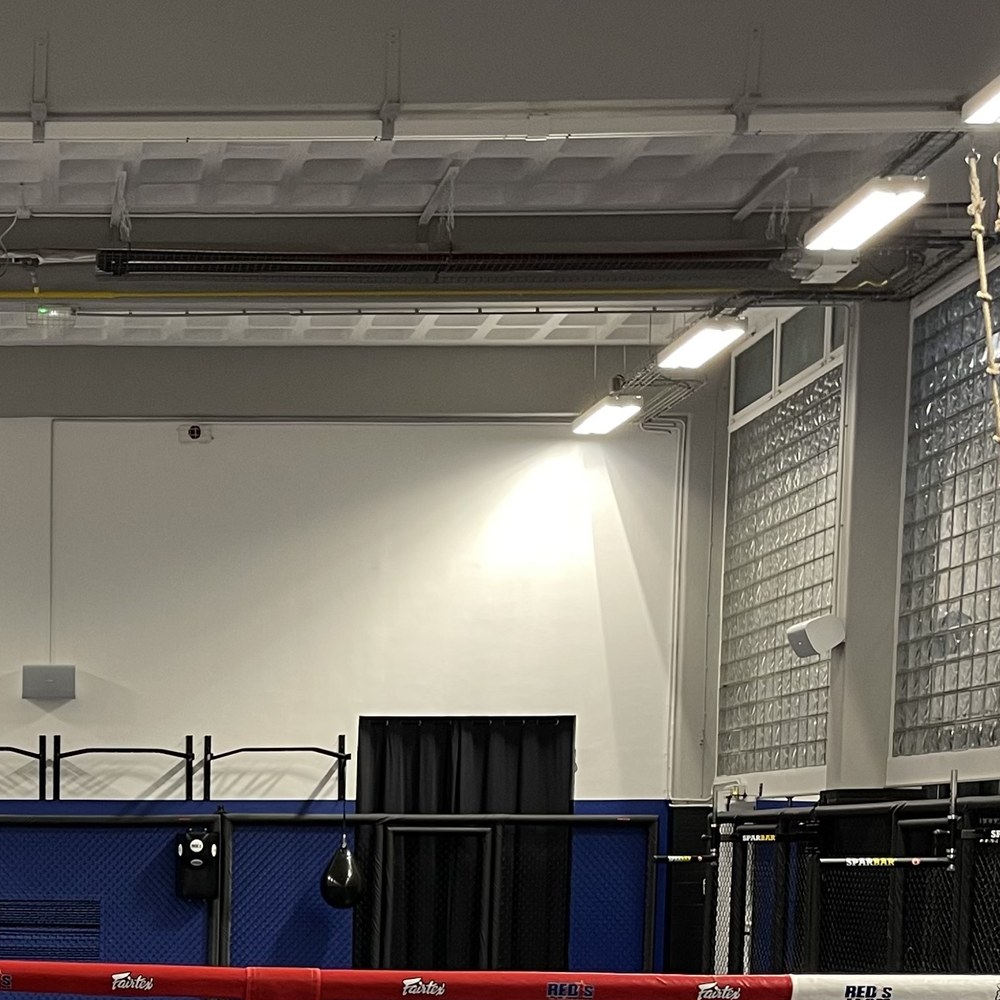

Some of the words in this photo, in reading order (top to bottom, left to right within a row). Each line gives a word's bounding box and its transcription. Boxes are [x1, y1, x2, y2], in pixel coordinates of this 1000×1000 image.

[112, 972, 153, 990] Fairtex
[402, 977, 445, 996] Fairtex
[697, 981, 741, 1000] Fairtex
